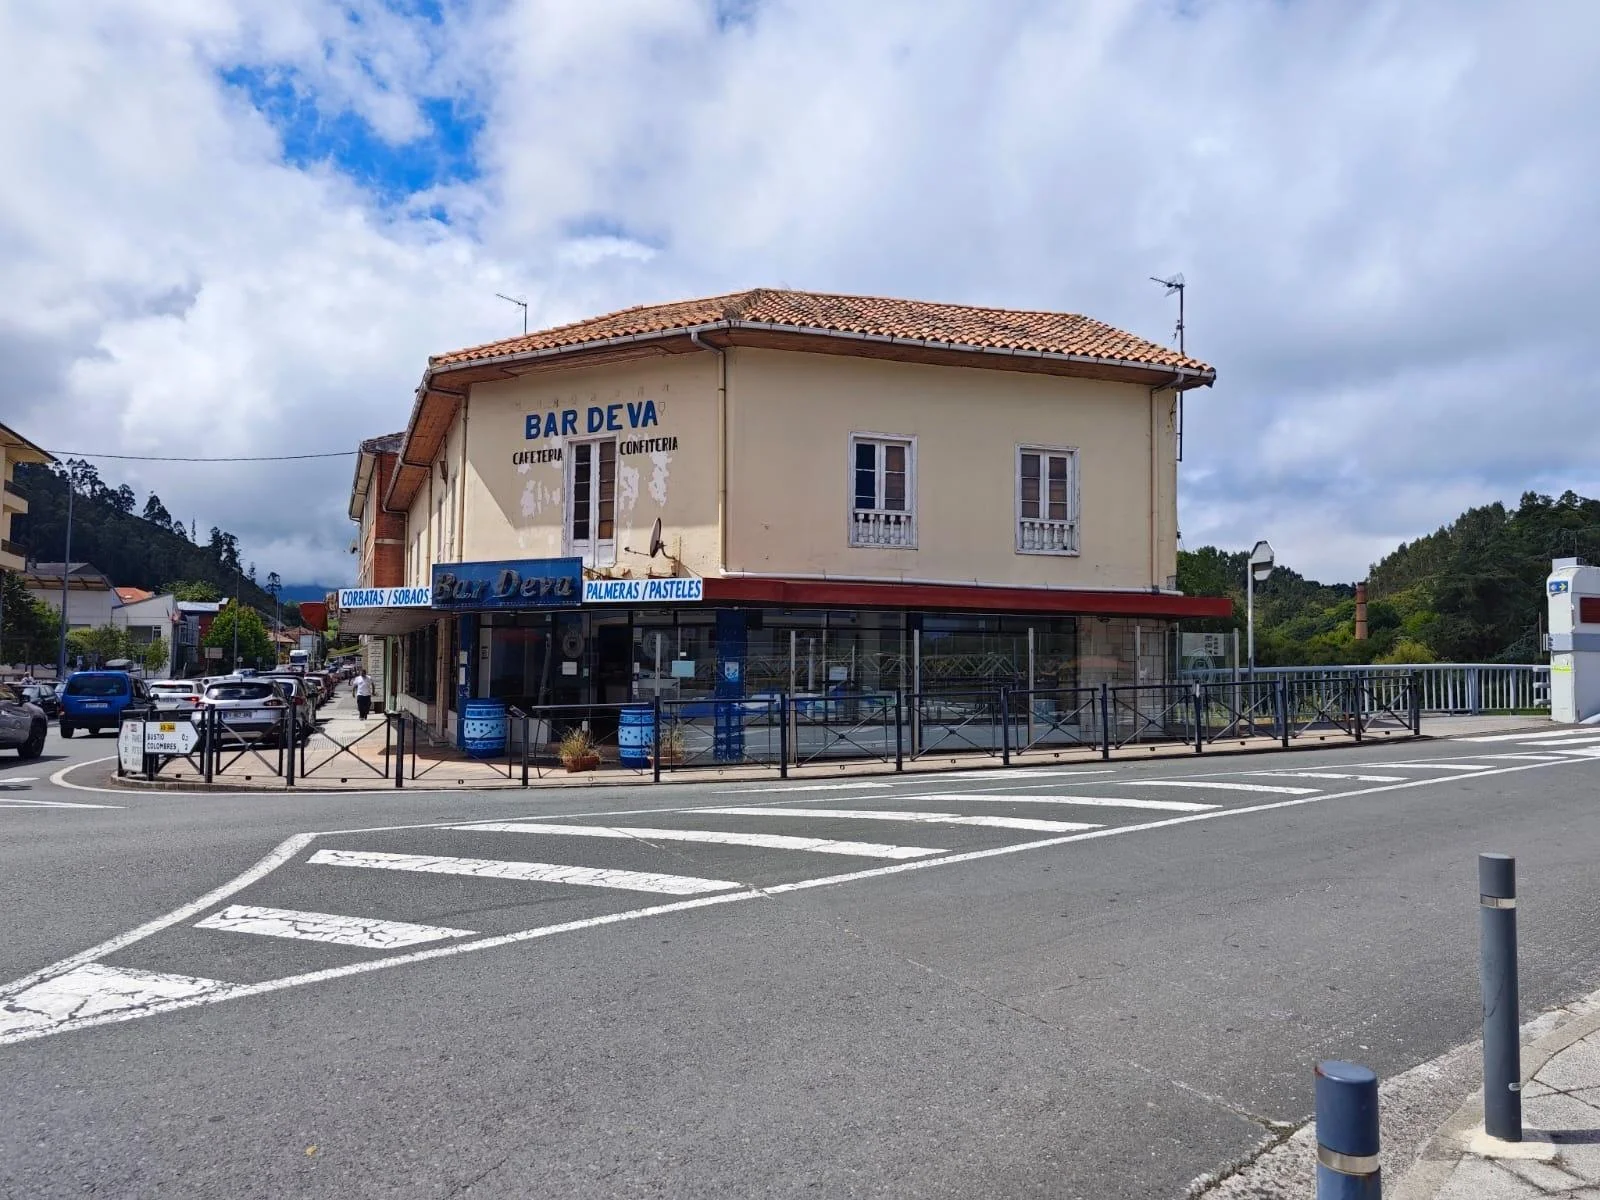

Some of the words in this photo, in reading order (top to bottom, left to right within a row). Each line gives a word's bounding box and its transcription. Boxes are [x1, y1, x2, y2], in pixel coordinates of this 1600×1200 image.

[525, 409, 578, 440] BAR
[587, 400, 659, 433] DEVA
[619, 436, 679, 456] CONFITERIA
[512, 447, 563, 466] CAFETERIA
[433, 571, 491, 600] Bar
[492, 569, 575, 598] Deva
[586, 582, 640, 600] PALMERAS
[342, 590, 385, 607] CORBATAS
[147, 742, 177, 750] COLOMBRES
